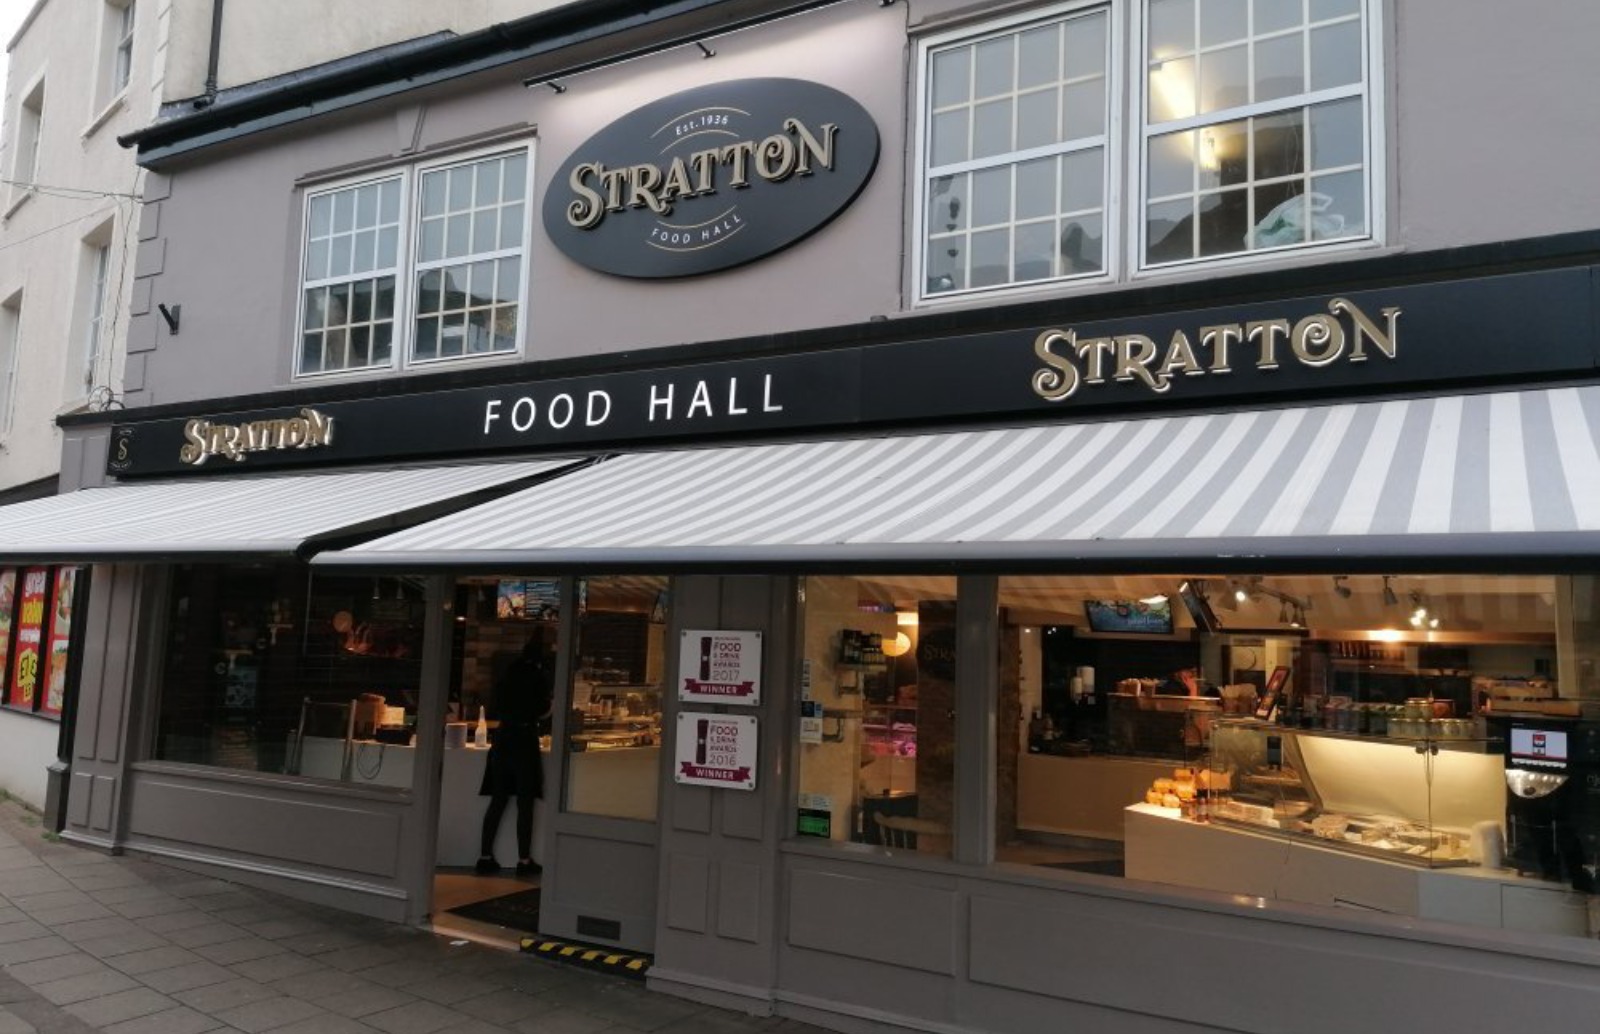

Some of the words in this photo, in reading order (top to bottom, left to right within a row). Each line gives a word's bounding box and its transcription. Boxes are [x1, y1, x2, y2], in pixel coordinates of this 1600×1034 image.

[567, 117, 838, 229] STRATTON
[652, 228, 691, 244] FOOD
[702, 214, 742, 241] HALL
[1032, 297, 1402, 401] STRATTON
[484, 390, 611, 434] FOOD
[649, 374, 783, 421] HALL
[713, 642, 741, 652] FOOD
[712, 670, 740, 681] 2017
[700, 685, 738, 695] WINNER
[710, 725, 738, 736] FOOD
[709, 753, 737, 766] 2016
[695, 768, 734, 780] WINNER
